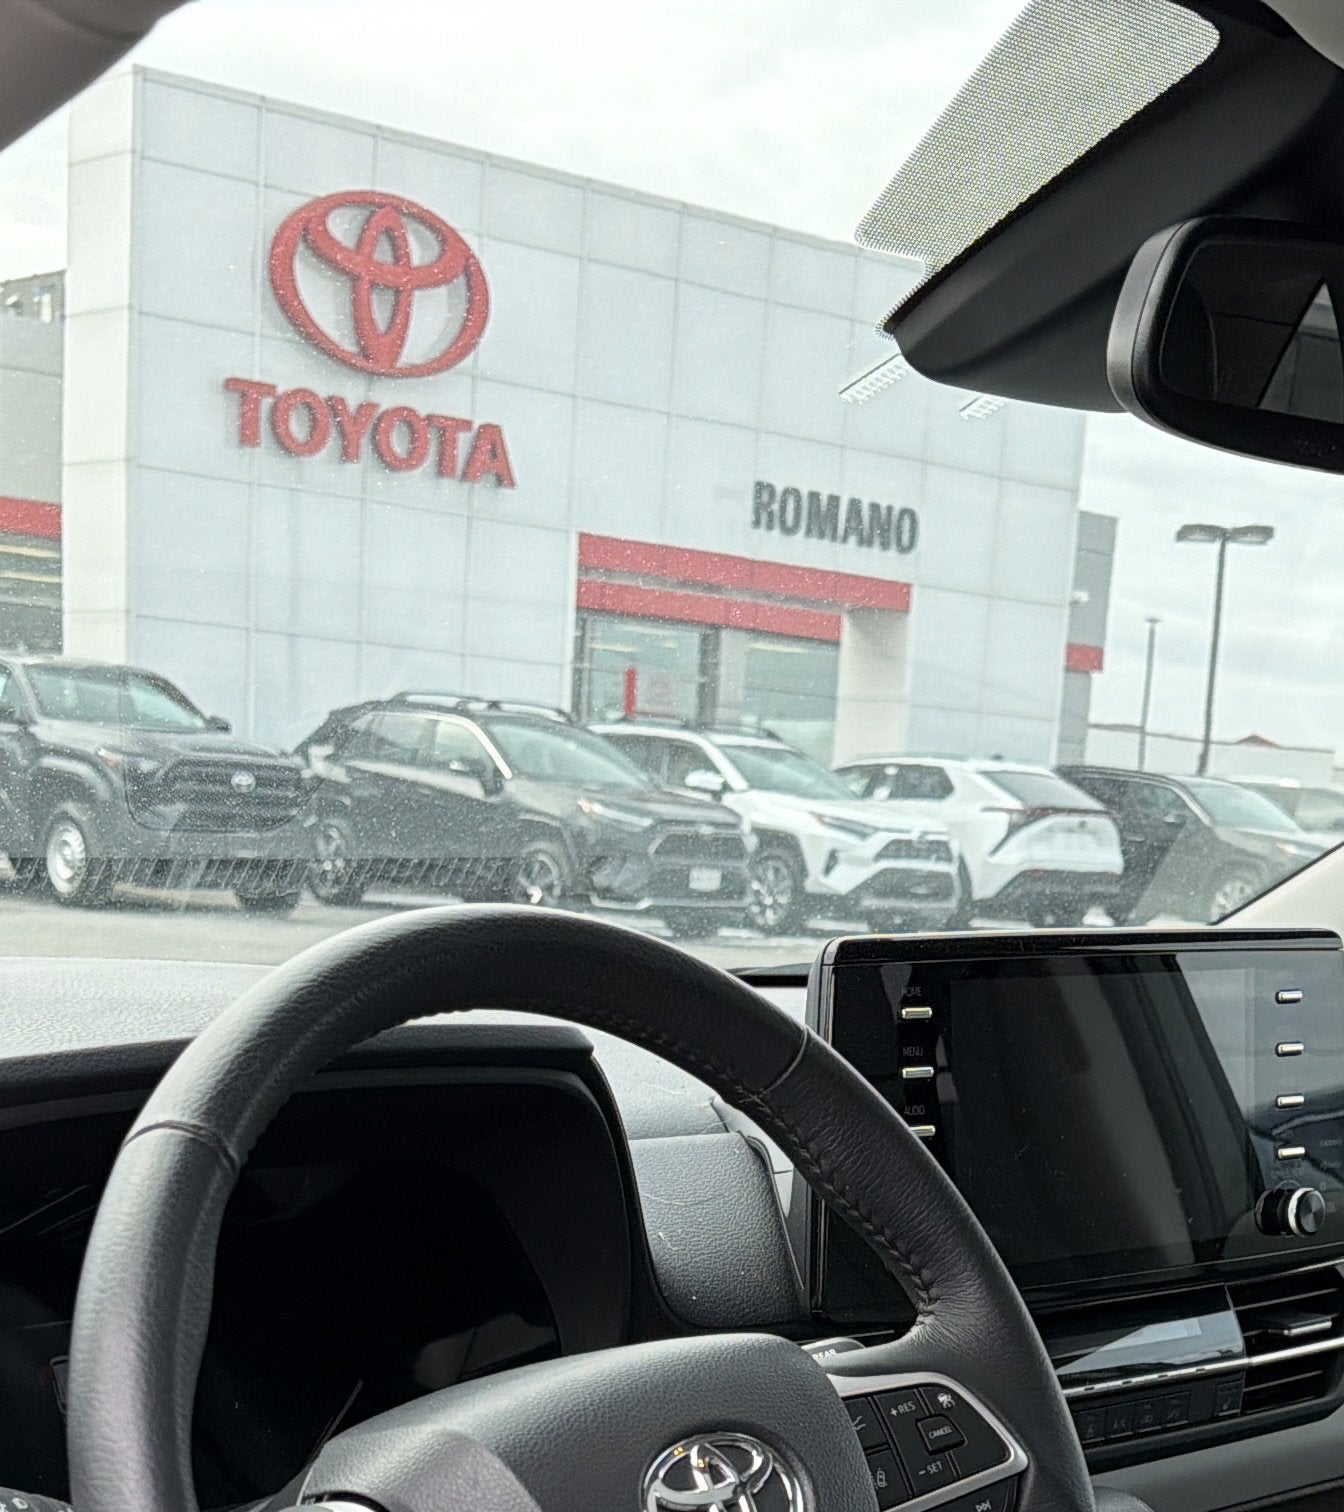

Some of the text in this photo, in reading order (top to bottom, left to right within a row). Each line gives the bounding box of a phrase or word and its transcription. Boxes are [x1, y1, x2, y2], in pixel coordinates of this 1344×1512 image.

[223, 377, 517, 490] TOYOTA
[751, 480, 920, 554] ROMANO
[901, 986, 923, 997] HOME
[902, 1046, 924, 1057] MENU
[904, 1105, 926, 1116] AUDIO
[928, 1425, 953, 1439] CANCEL
